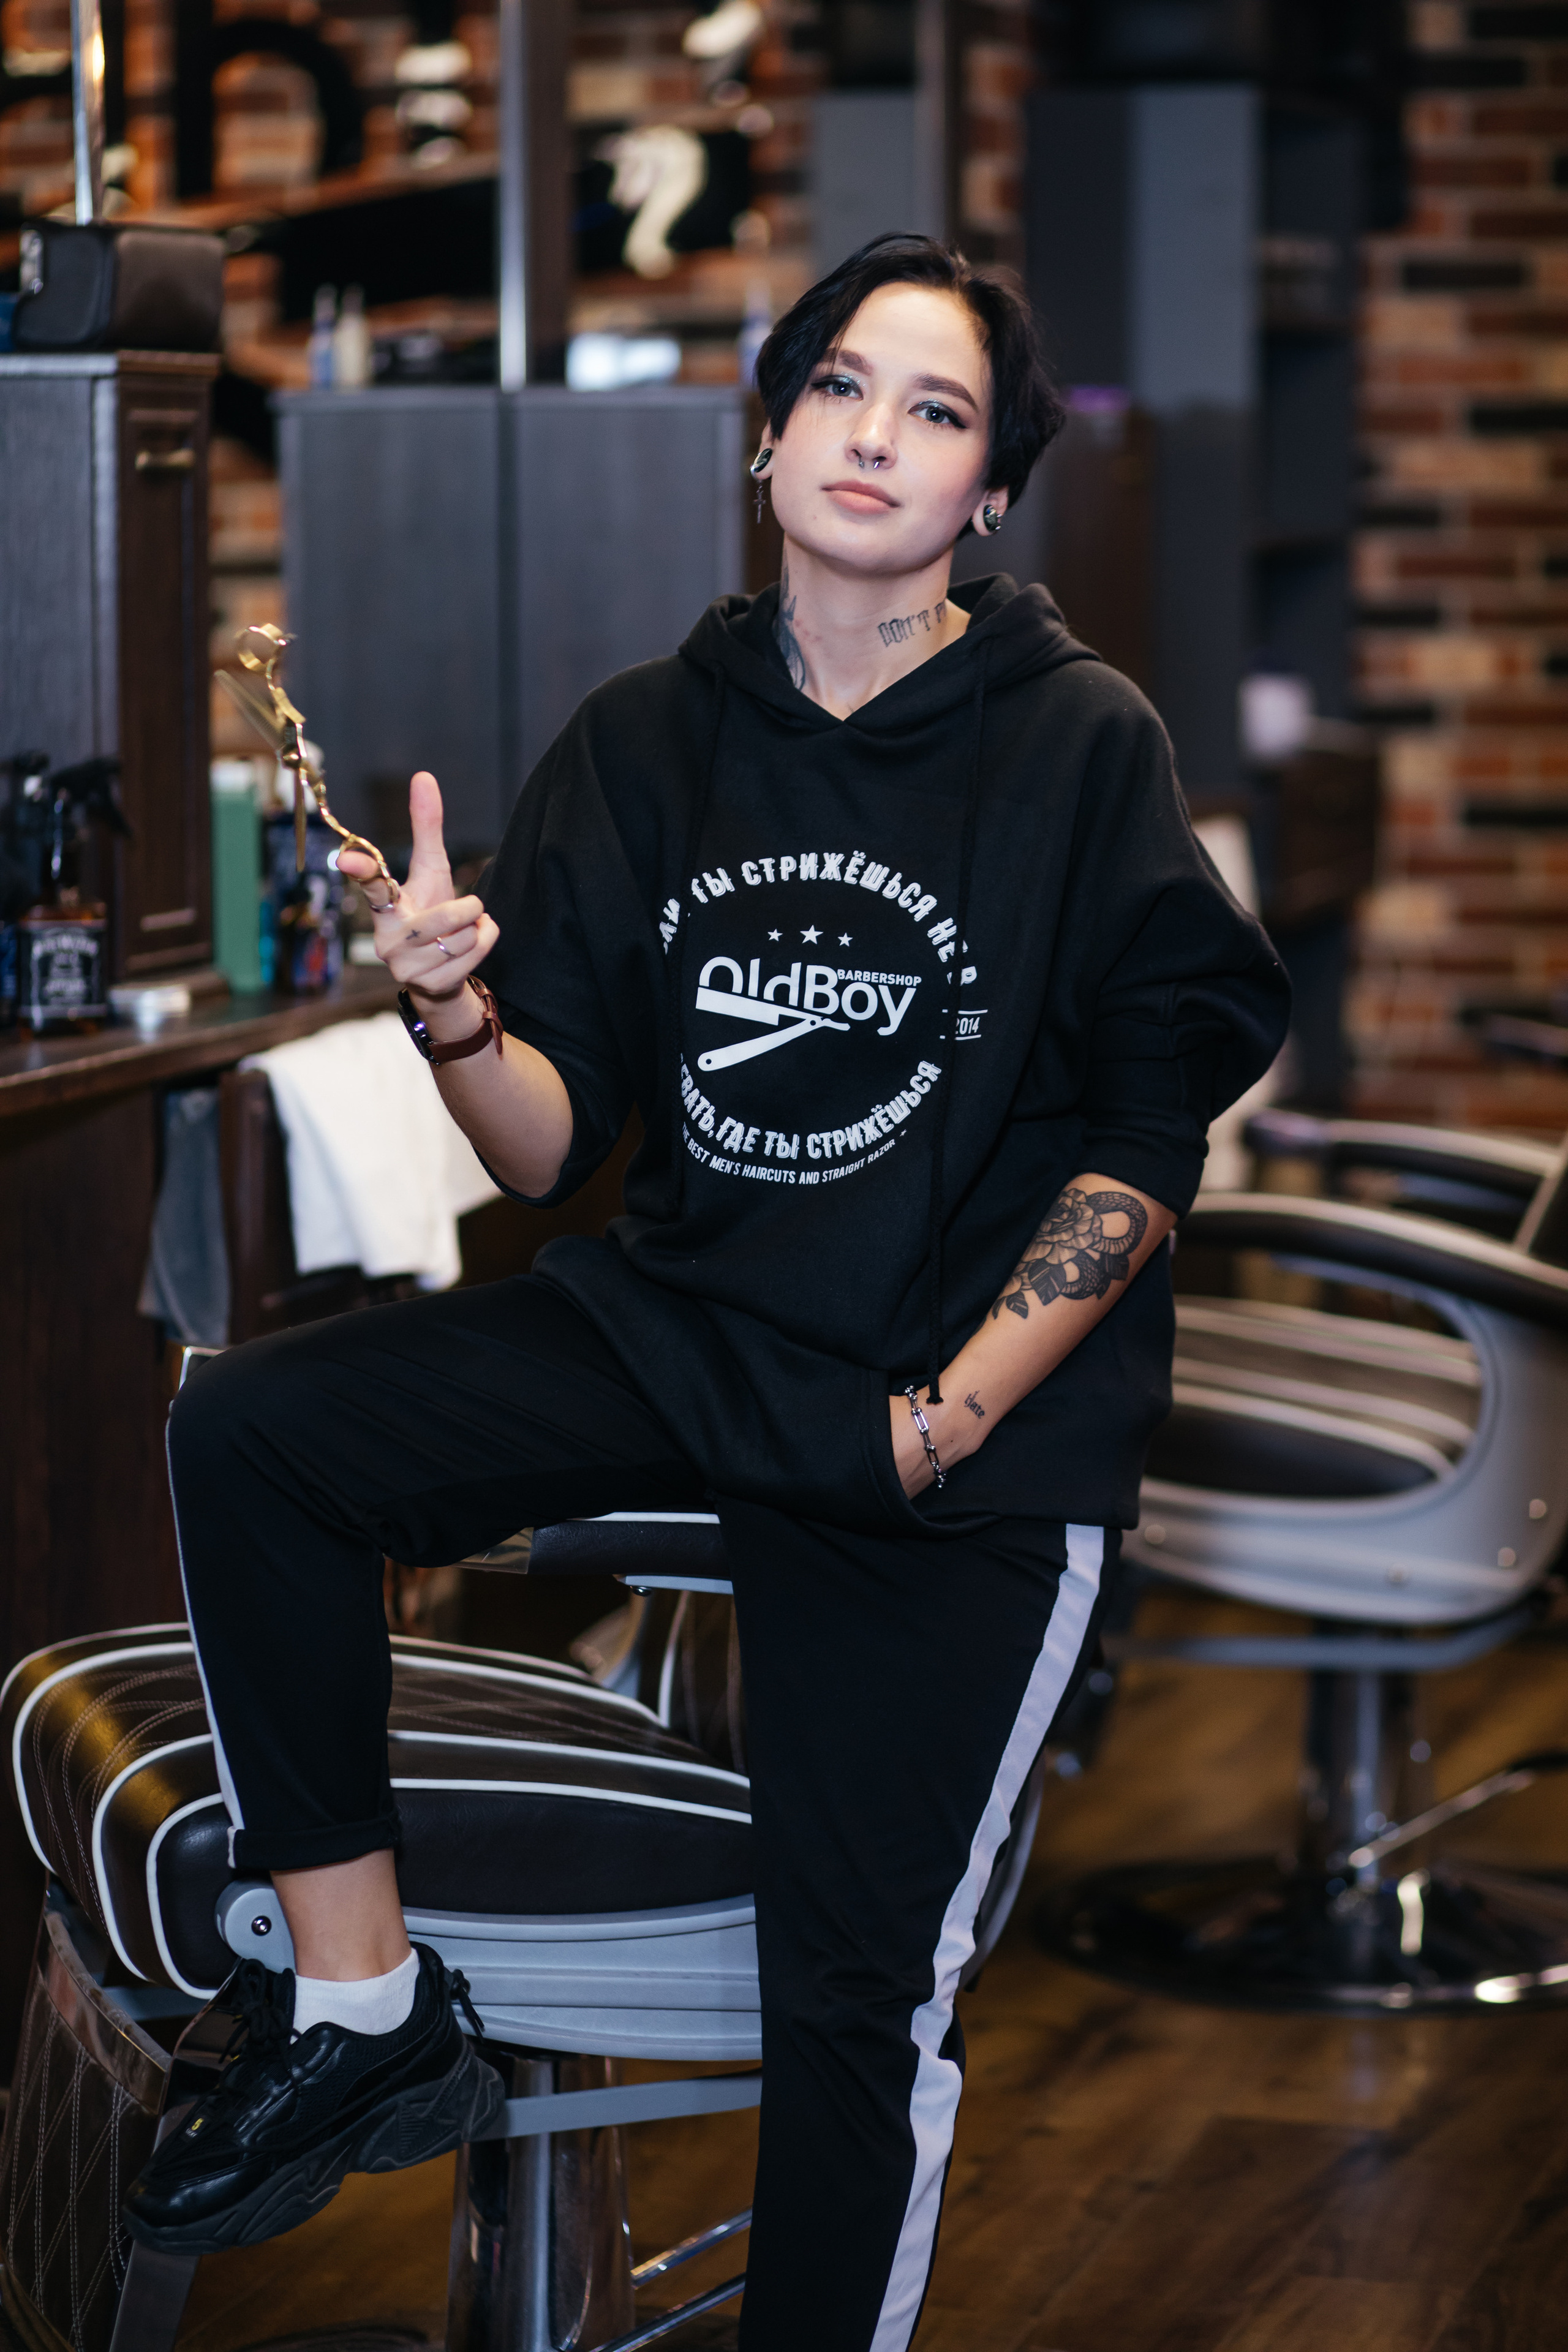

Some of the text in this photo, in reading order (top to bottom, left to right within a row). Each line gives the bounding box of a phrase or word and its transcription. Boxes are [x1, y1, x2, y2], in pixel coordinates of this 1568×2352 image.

[741, 850, 938, 922] СТРИЖЁШЬСЯ
[837, 968, 922, 987] BARBERSHOP
[715, 1116, 761, 1153] ГДЕ
[763, 1131, 800, 1160] ТЫ
[805, 1060, 943, 1160] СТРИЖЁШЬСЯ
[687, 1137, 710, 1163] BEST
[709, 1155, 742, 1176] MEN'S
[741, 1164, 796, 1185] HAIRCUTS
[798, 1170, 820, 1185] AND
[821, 1157, 866, 1183] STRAIGHT
[867, 1138, 896, 1164] RAZOR
